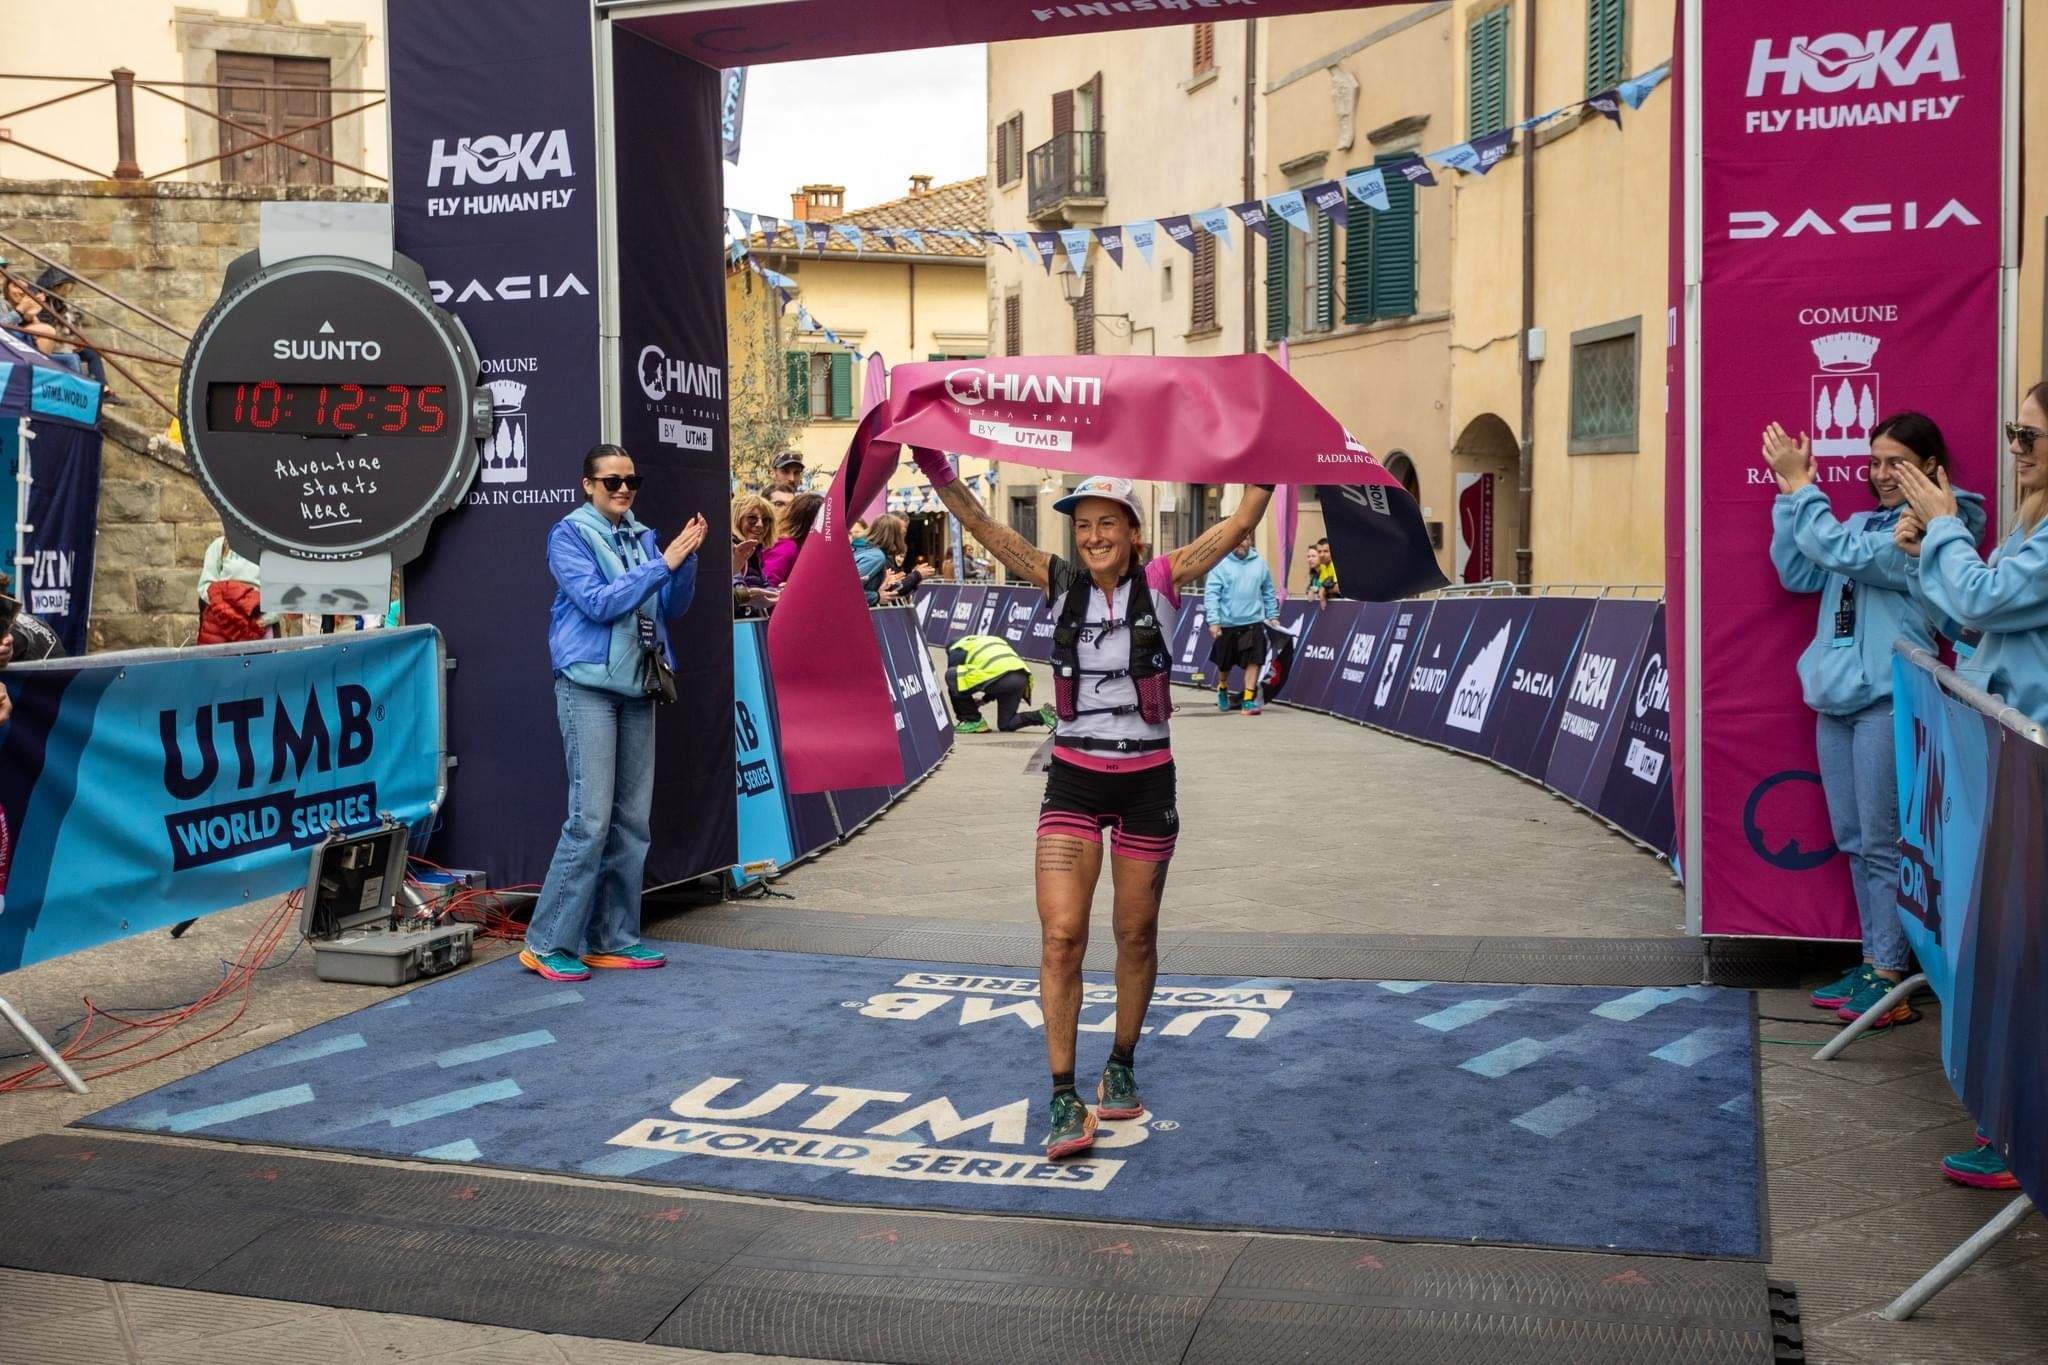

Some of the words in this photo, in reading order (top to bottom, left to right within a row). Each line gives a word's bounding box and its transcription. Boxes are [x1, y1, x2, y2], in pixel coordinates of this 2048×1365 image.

[1746, 22, 1960, 97] HOKA
[1746, 109, 1792, 133] FLY
[1796, 101, 1906, 130] HUMAN
[1912, 95, 1960, 121] FLY
[427, 129, 573, 187] HOKA
[428, 197, 461, 217] FLY
[464, 192, 538, 215] HUMAN
[542, 189, 573, 209] FLY
[1729, 198, 1982, 239] DACIA
[428, 272, 590, 303] DACIA
[1799, 305, 1898, 325] COMUNE
[273, 339, 381, 361] SUUNTO
[480, 358, 538, 374] OMUNE
[638, 345, 722, 400] CHIANTI
[63, 388, 88, 409] WORLD
[945, 367, 1101, 406] CHIANTI
[234, 380, 444, 432] 10:12:35
[646, 403, 684, 415] ULTRA
[693, 409, 720, 421] TRAIL
[954, 407, 1014, 419] ULTRA
[1032, 414, 1091, 424] TRAIL
[664, 424, 675, 438] BY
[685, 430, 707, 446] UTMB
[978, 424, 996, 436] BY
[1015, 431, 1059, 447] UTMB
[1317, 455, 1352, 464] RADDA
[1353, 455, 1364, 463] IN
[1747, 467, 1823, 484] RAA
[1827, 466, 1850, 482] IN
[493, 490, 509, 505] IN
[512, 489, 575, 504] CHIANTI
[825, 497, 833, 542] COMUNE
[289, 549, 363, 560] SUUNTO
[1304, 644, 1335, 661] DACIA
[1410, 666, 1447, 694] SUUNTO
[1512, 667, 1555, 698] DACIA
[1569, 652, 1617, 711] HOKA
[160, 682, 374, 800] UTMB
[744, 766, 770, 790] SERIES
[177, 806, 280, 857] WORLD
[291, 794, 370, 839] SERIES
[916, 975, 1040, 992] ERIES
[1085, 991, 1267, 1006] WORD
[646, 1126, 870, 1161] WORLD
[887, 1153, 1099, 1183] SERIES
